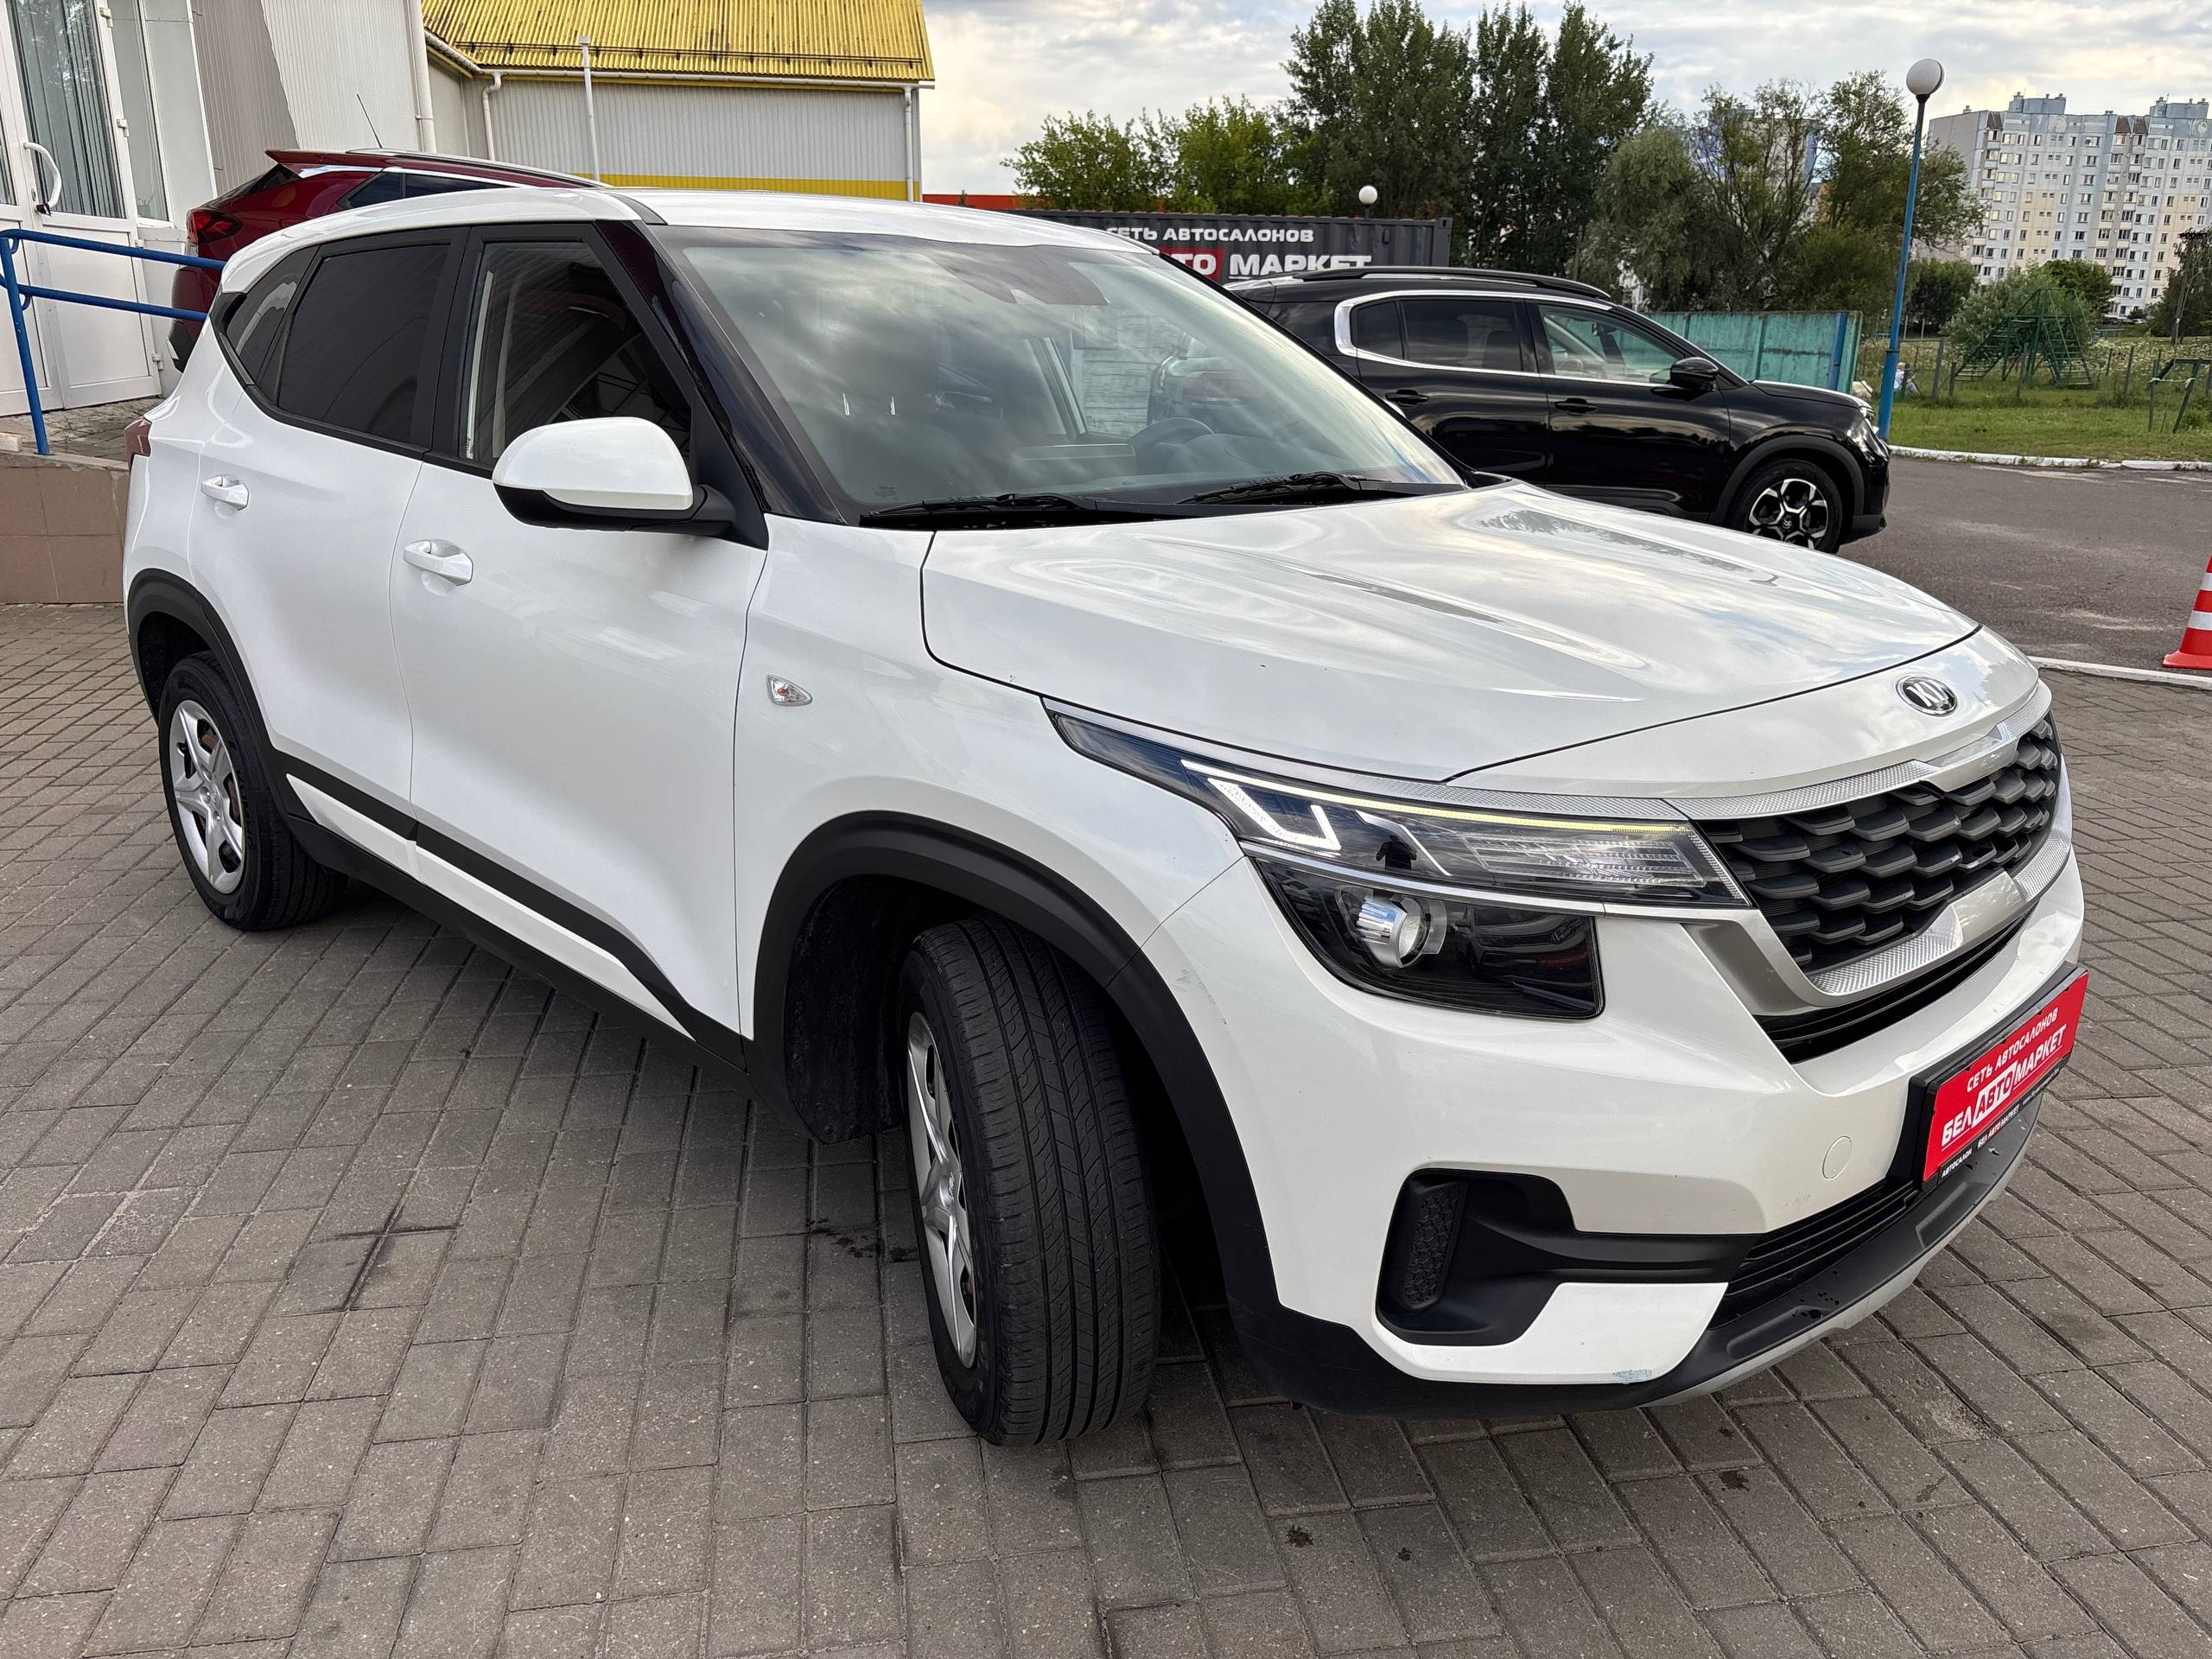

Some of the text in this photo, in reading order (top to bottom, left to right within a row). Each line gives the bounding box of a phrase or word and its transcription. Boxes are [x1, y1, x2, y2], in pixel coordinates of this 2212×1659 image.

[1163, 228, 1314, 242] АВТОСАЛОНОВ
[1967, 1064, 1993, 1092] СЕТЬ
[1995, 1007, 2058, 1071] АВТОСАЛОНОВ
